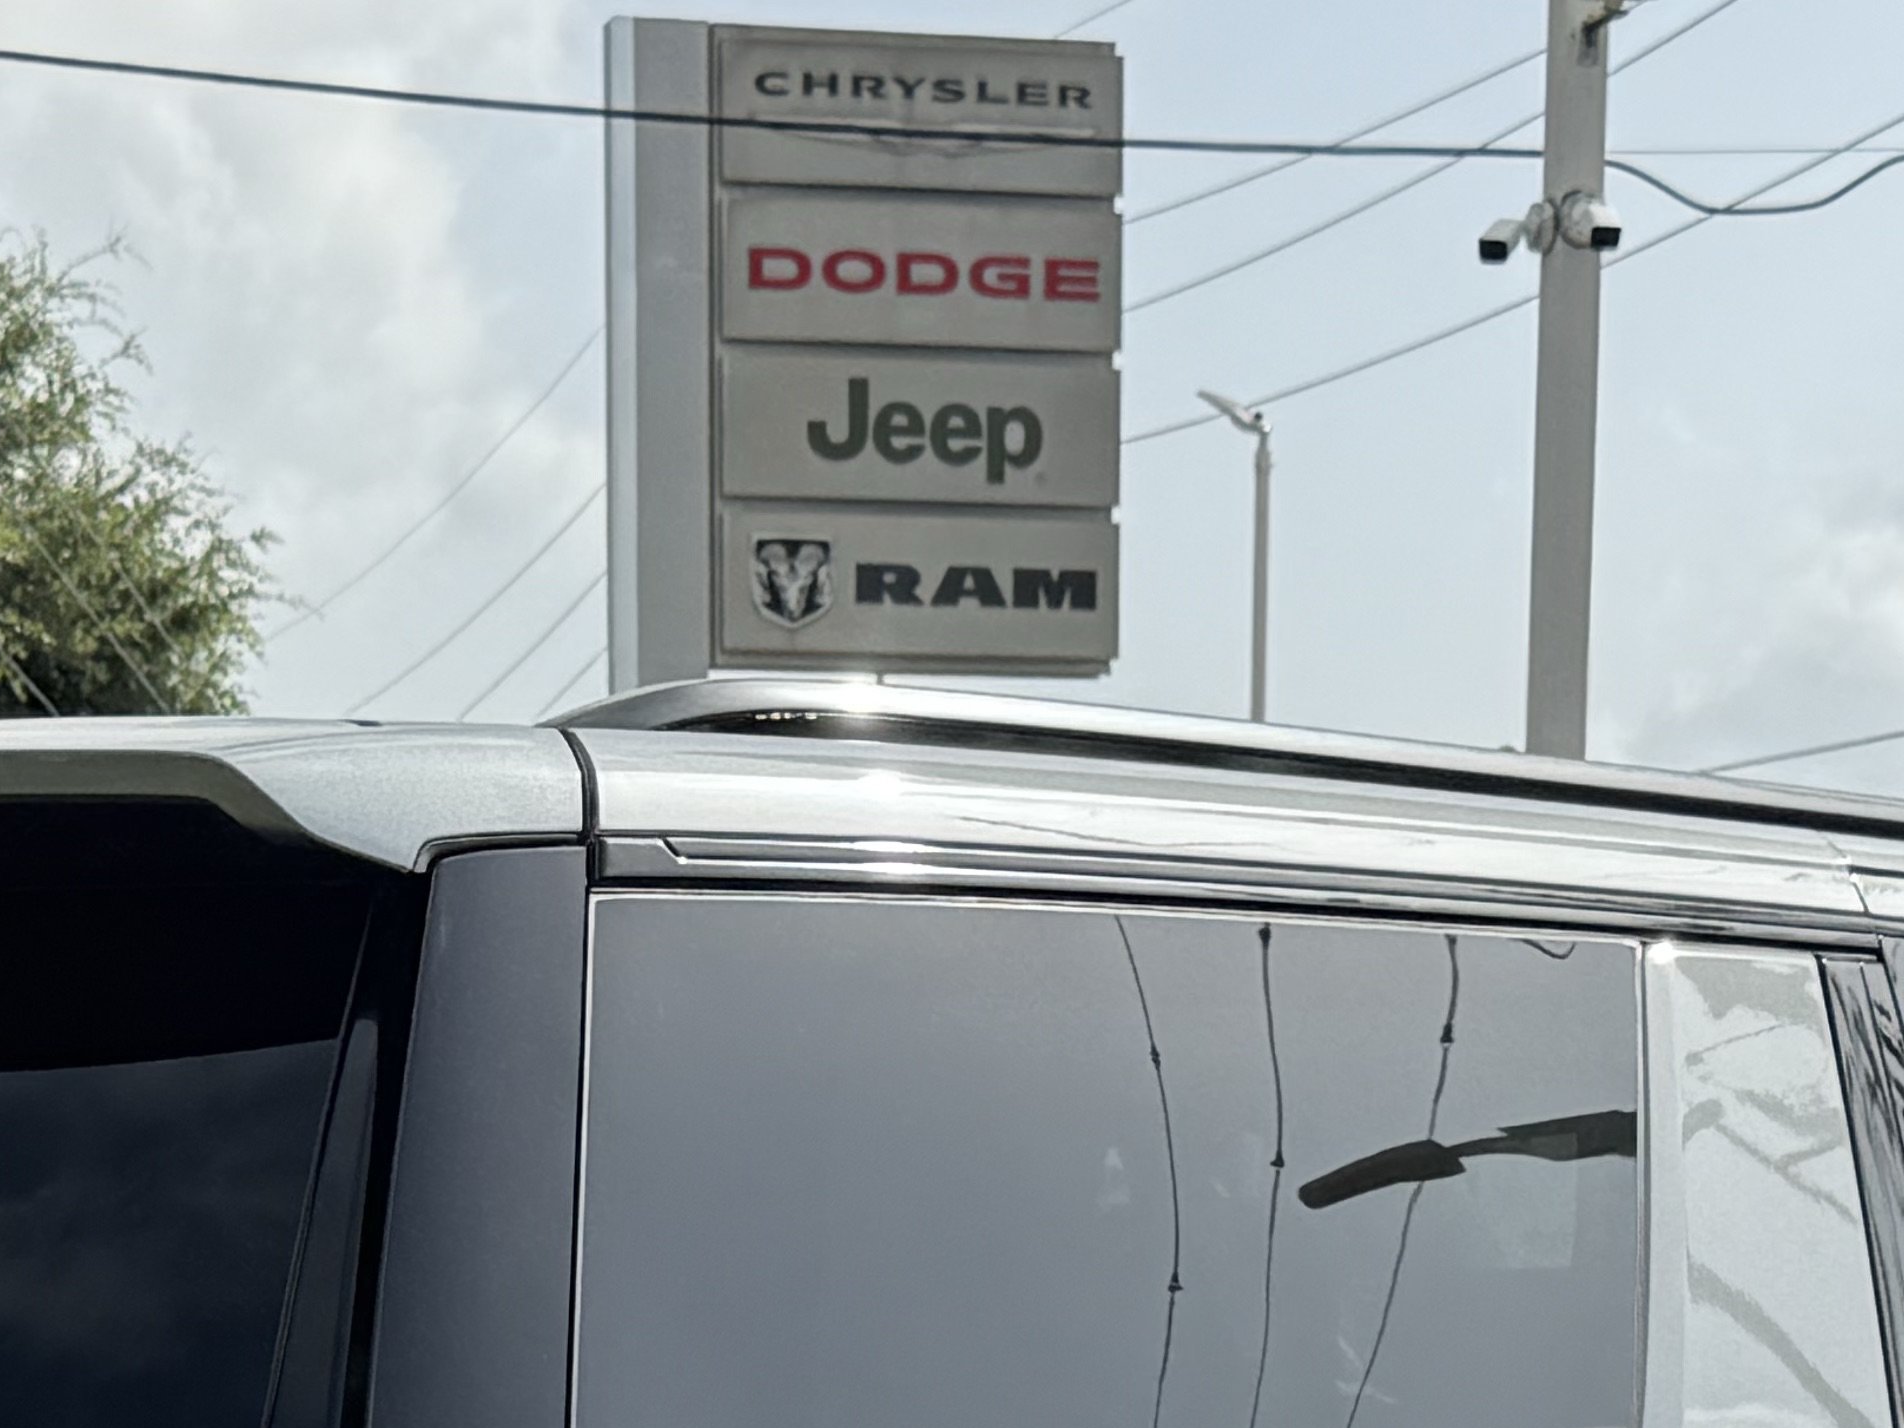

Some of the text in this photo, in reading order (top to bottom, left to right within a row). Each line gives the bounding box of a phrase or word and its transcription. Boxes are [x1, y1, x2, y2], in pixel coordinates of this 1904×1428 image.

[753, 70, 1094, 110] CHRYSLER
[747, 247, 1102, 302] DODGE
[806, 377, 1044, 485] Jeep
[854, 562, 1097, 611] RAM
